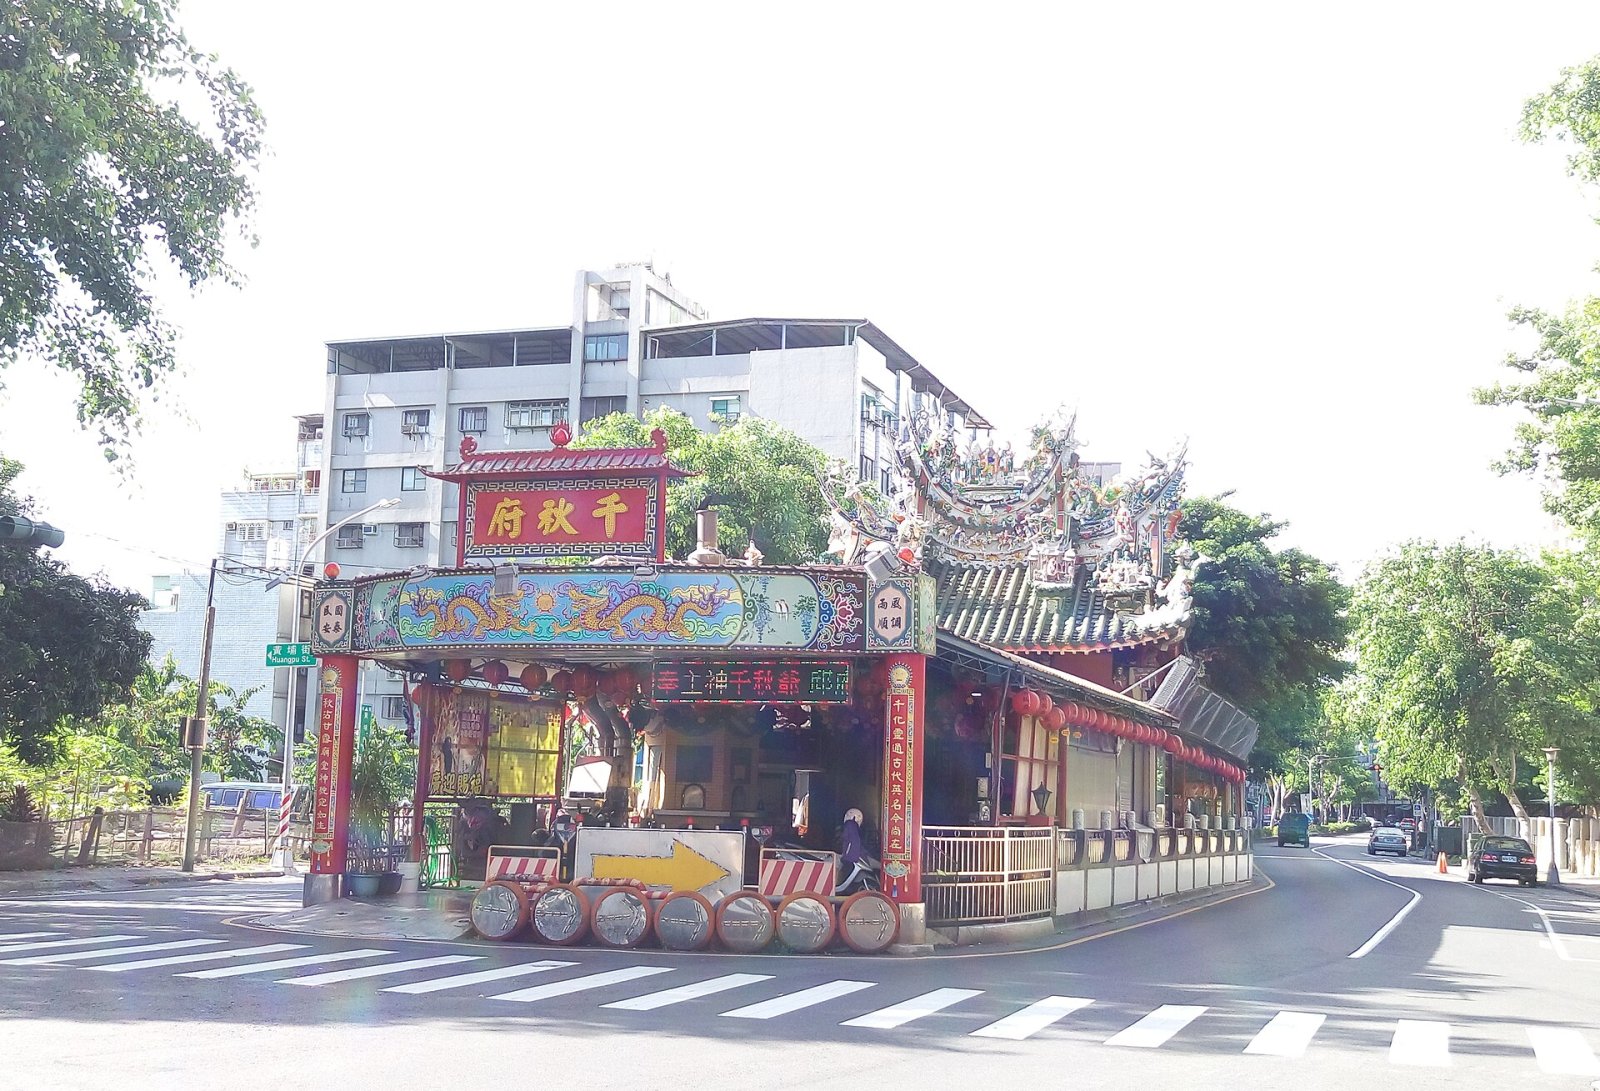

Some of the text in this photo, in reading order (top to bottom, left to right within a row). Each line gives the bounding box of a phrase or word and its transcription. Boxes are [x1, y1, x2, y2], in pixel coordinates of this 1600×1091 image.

[487, 492, 629, 539] 千秋府
[272, 656, 300, 664] Huangpu
[889, 698, 906, 849] 千化靈通古代英名今尚在
